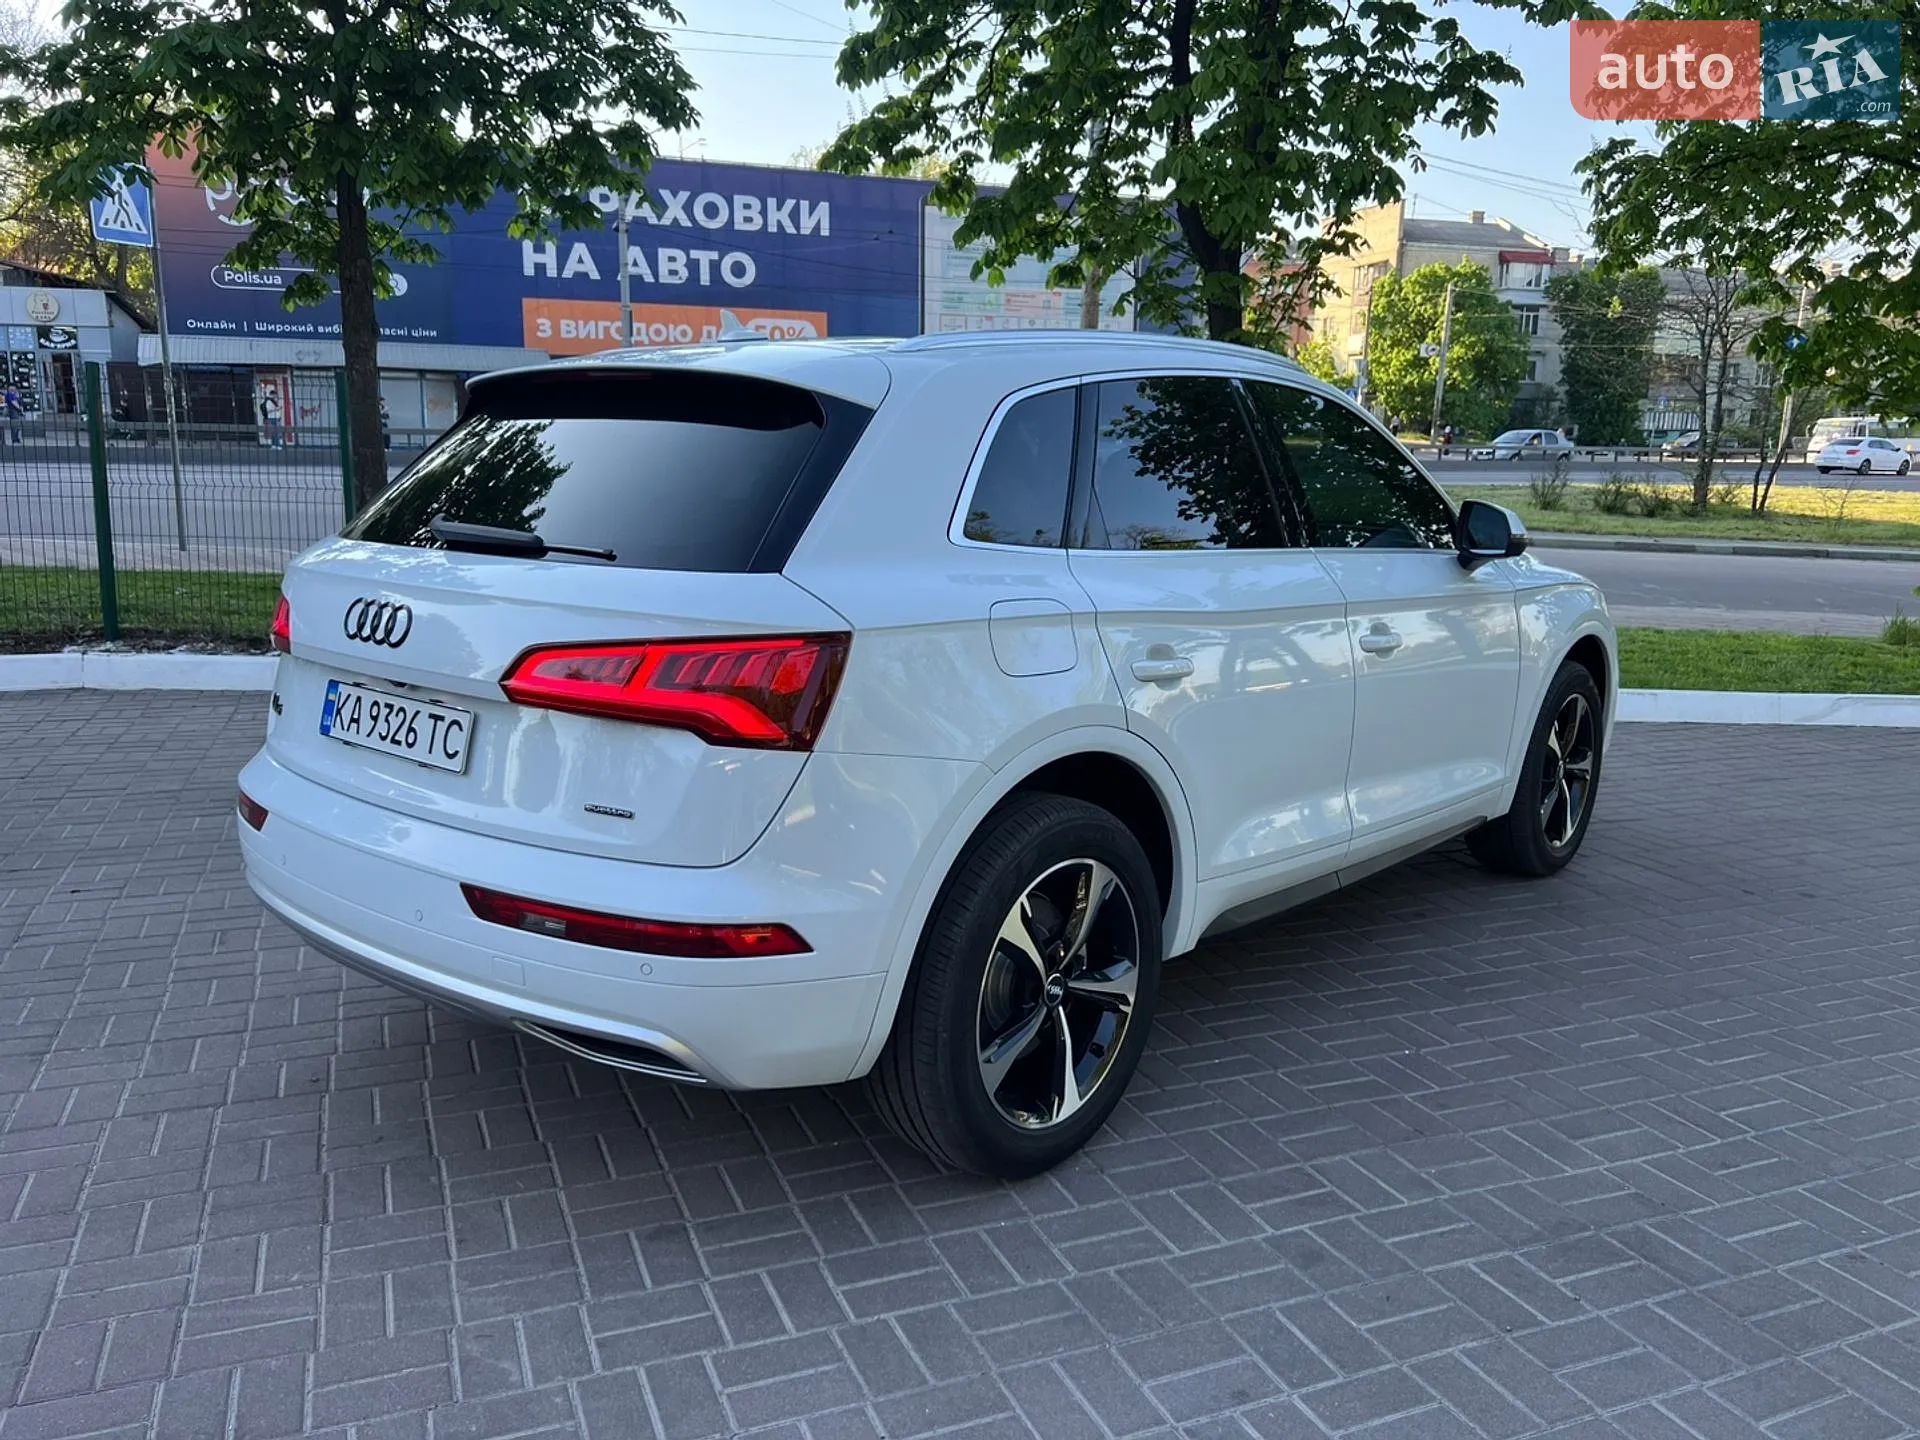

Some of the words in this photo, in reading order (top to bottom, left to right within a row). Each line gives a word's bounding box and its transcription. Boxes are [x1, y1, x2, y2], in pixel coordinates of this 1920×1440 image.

[521, 239, 600, 280] НА
[617, 245, 756, 288] АВТО
[224, 271, 283, 286] Polis.ua
[186, 319, 236, 330] Онлайн
[254, 321, 315, 333] Широкий
[317, 323, 343, 334] вибі
[411, 327, 438, 338] ціни
[560, 320, 693, 344] ВИГОДОЮ
[333, 691, 362, 735] KA
[366, 700, 421, 749] 9326
[428, 712, 464, 760] TC
